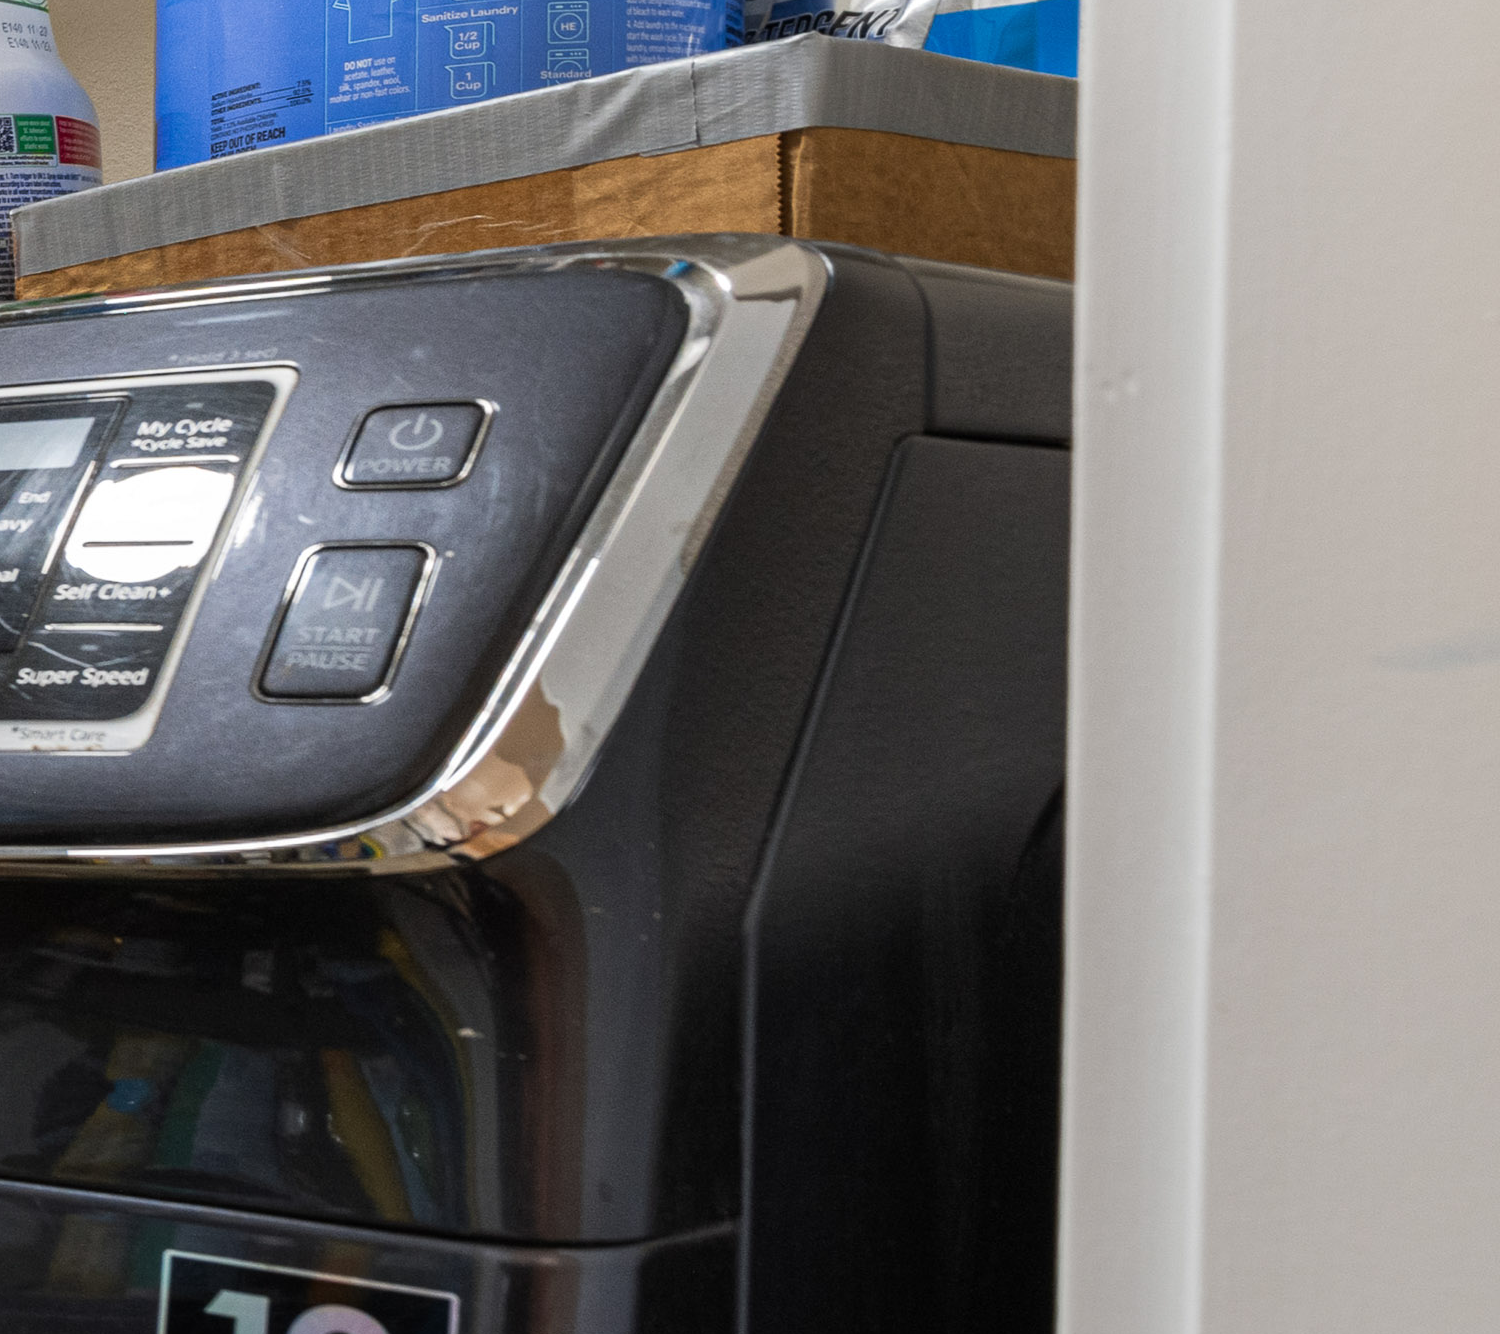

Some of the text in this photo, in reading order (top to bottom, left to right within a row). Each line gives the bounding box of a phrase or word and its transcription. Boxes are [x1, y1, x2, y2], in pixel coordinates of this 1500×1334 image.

[422, 5, 518, 23] Sanitize Laundry
[560, 22, 576, 31] HE
[458, 31, 478, 41] 1/2
[455, 41, 480, 51] Cup
[344, 58, 372, 71] DO NOT
[540, 69, 592, 79] Standard
[456, 81, 481, 91] Cup
[211, 139, 227, 154] KEEP
[229, 136, 243, 149] OUT
[245, 134, 256, 146] OF
[257, 127, 286, 143] REACH
[137, 418, 233, 439] My Cycle
[185, 435, 228, 448] Save
[360, 456, 453, 474] POWER
[18, 491, 51, 504] End
[54, 584, 173, 601] Self Clean+
[298, 627, 381, 645] START
[286, 651, 372, 669] PAUSE
[17, 668, 149, 688] Super Speed
[69, 729, 106, 741] Care
